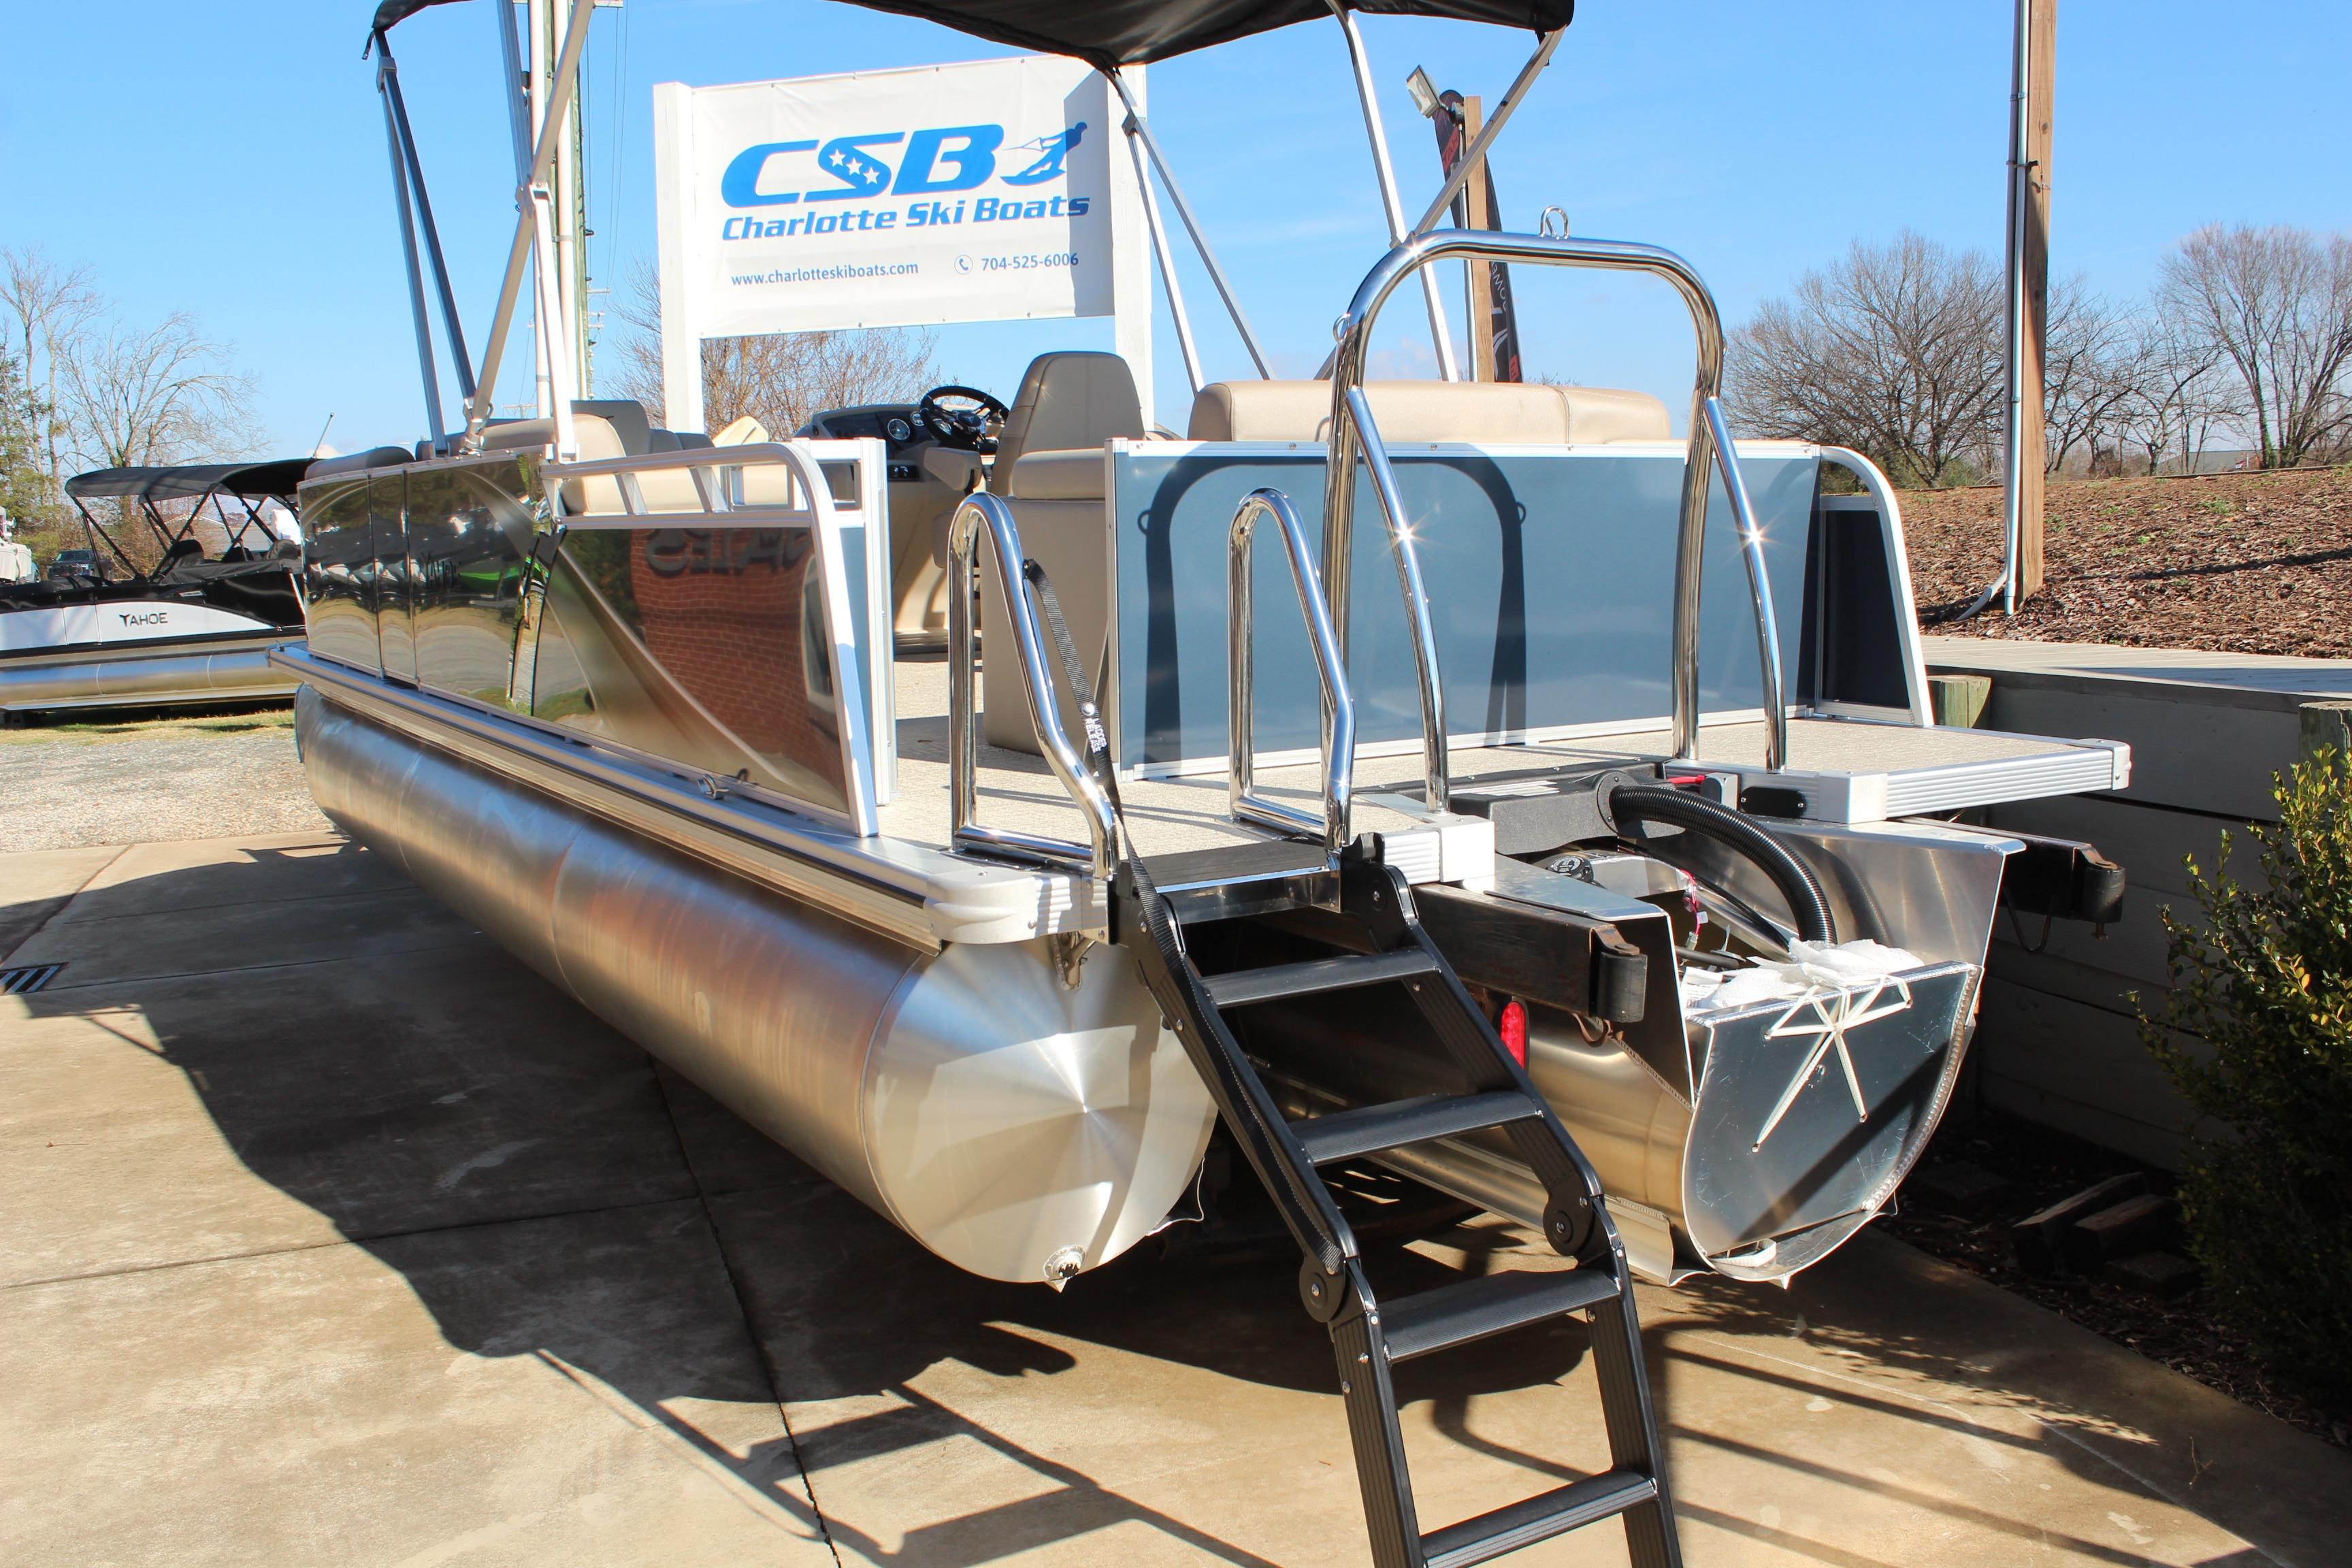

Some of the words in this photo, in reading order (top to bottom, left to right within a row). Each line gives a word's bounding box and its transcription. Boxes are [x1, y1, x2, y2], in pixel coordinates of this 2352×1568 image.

[721, 124, 1004, 208] CSB
[721, 210, 897, 241] Charlotte
[906, 200, 965, 227] Ski
[973, 196, 1090, 223] Boats
[731, 262, 919, 286] www.charlotteskiboats.com
[981, 252, 1079, 272] 704-525-6006
[119, 612, 169, 627] TAHOE
[1085, 718, 1101, 753] RELEASE
[1092, 718, 1107, 747] LADDER
